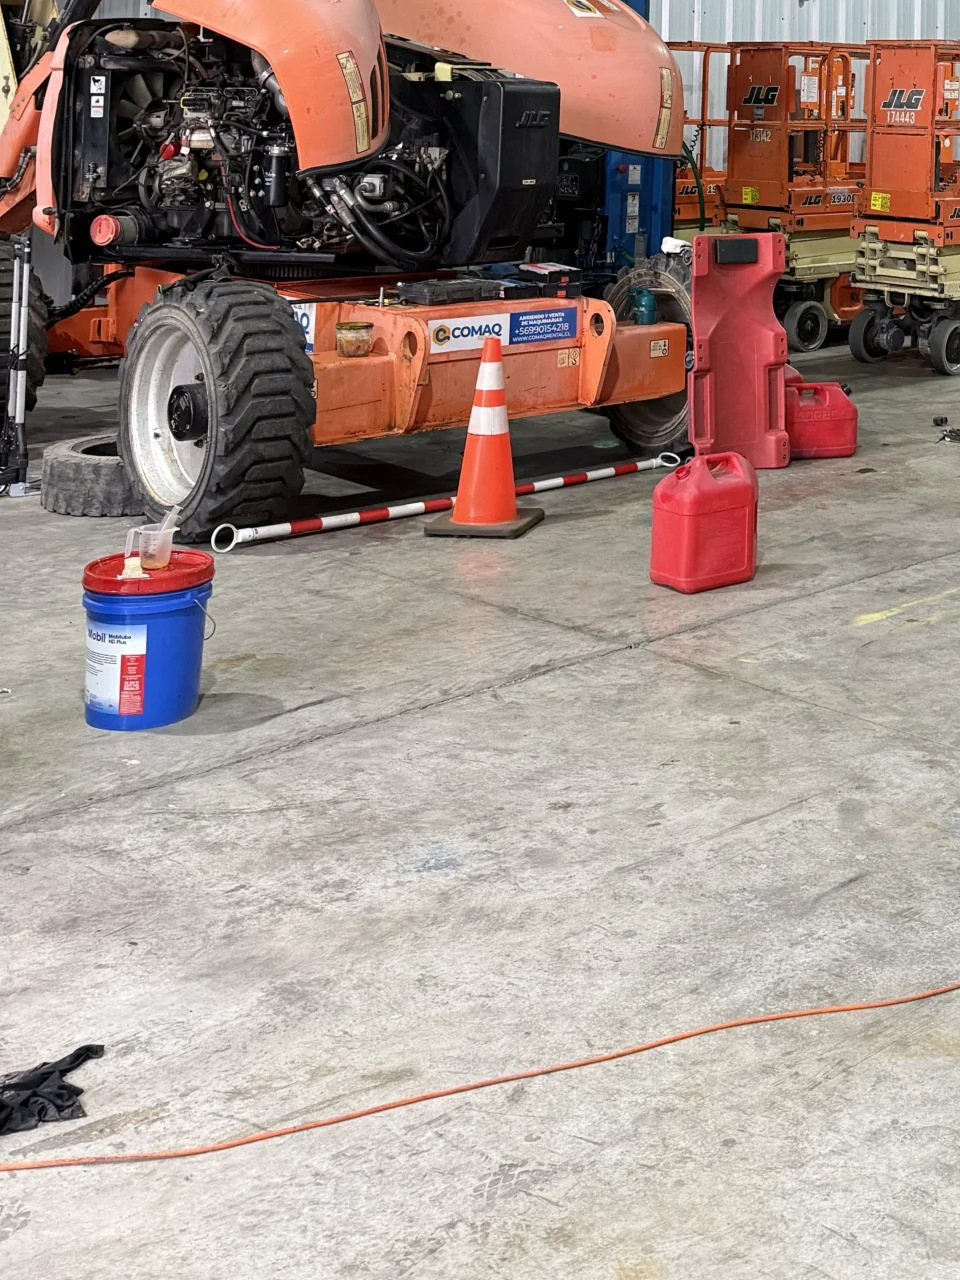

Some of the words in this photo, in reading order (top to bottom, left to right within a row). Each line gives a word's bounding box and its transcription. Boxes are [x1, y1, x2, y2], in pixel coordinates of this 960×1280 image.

[741, 85, 780, 107] JLG
[880, 89, 926, 111] JLG
[886, 111, 916, 124] 174443
[749, 130, 772, 142] 173142
[679, 185, 697, 196] JLG
[801, 194, 823, 206] JLG
[519, 313, 545, 321] ARRIENDO
[529, 317, 563, 326] MAQUINARIAS
[451, 322, 503, 339] COMAQ
[514, 322, 569, 336] +56990154218
[512, 331, 571, 342] WWW.COMAQRENTAL.CL
[88, 627, 106, 643] Mobil
